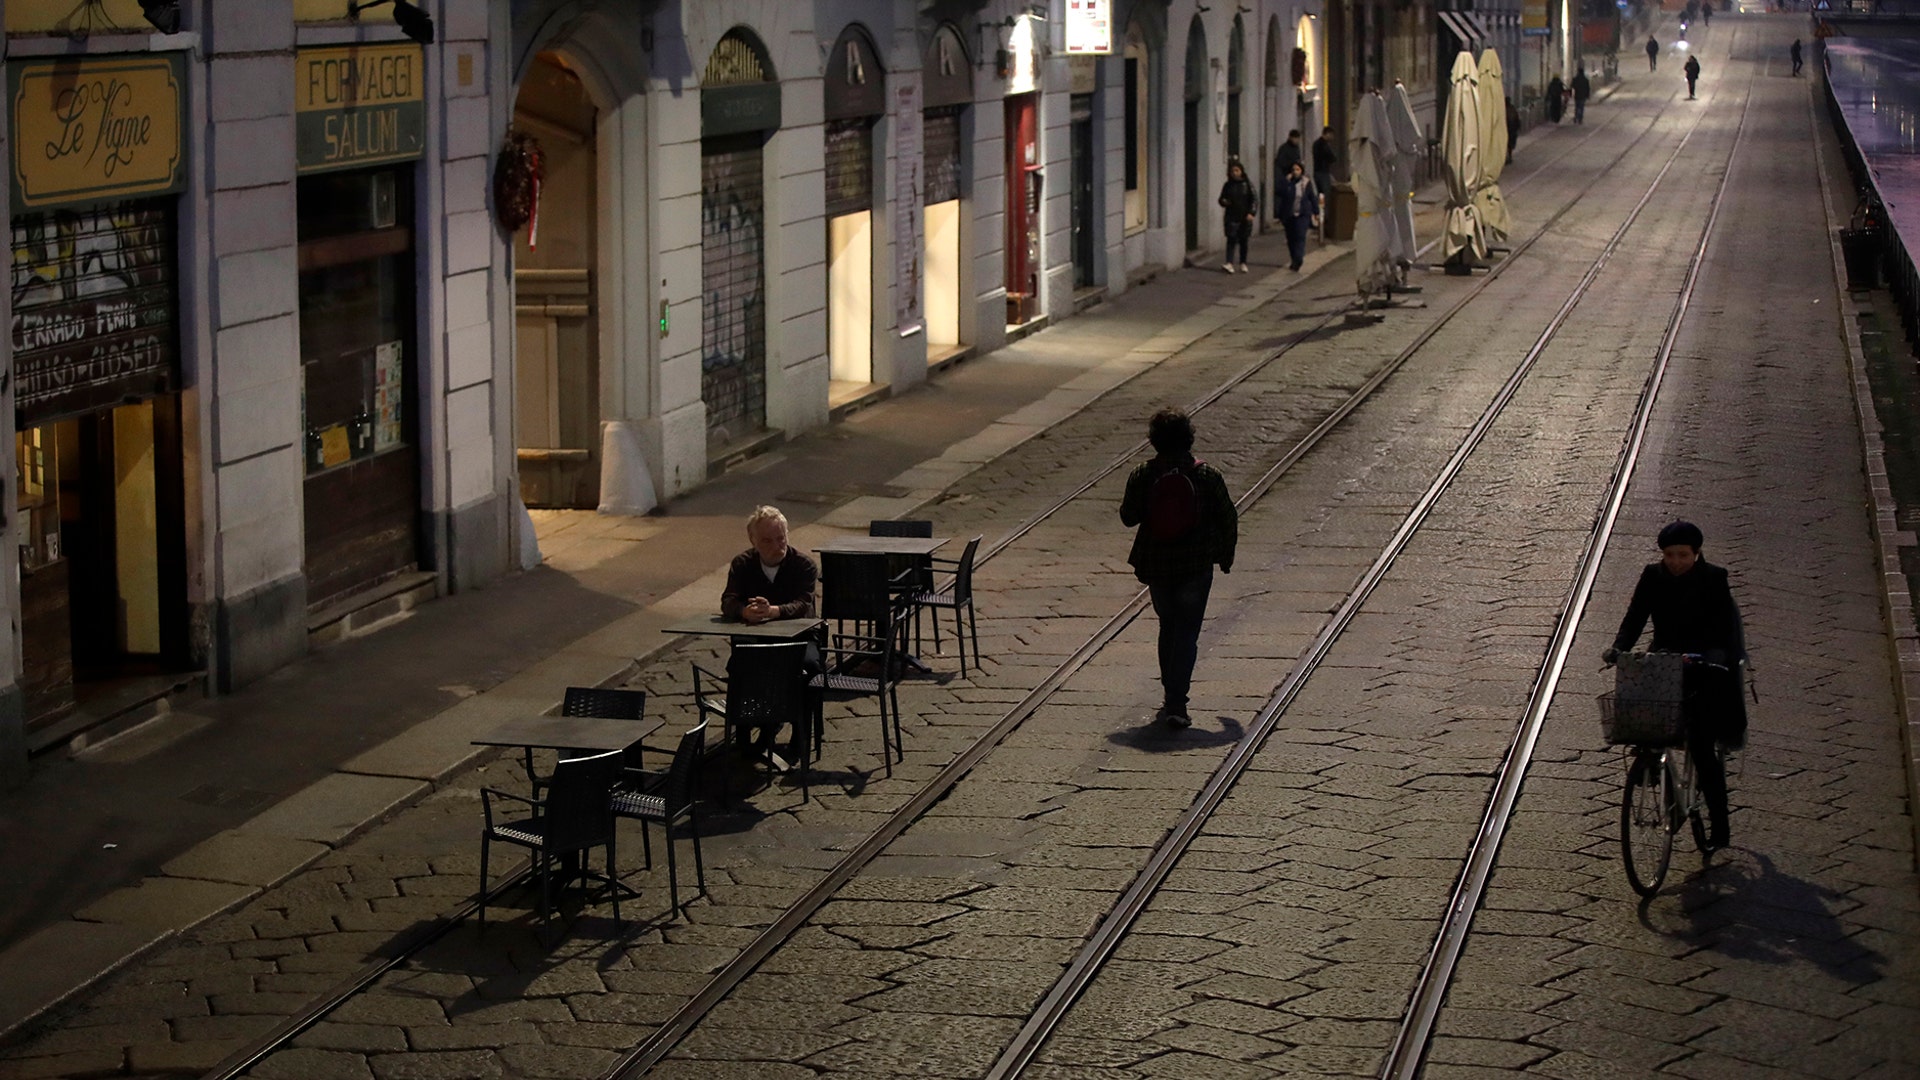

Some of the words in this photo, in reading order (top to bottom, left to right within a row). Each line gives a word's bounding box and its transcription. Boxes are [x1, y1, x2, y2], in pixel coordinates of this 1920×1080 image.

[308, 54, 412, 105] FORMAGGI
[46, 83, 89, 160] Le
[83, 78, 151, 178] Vigne
[324, 107, 399, 160] SALUMI
[12, 313, 85, 351] CERRADO
